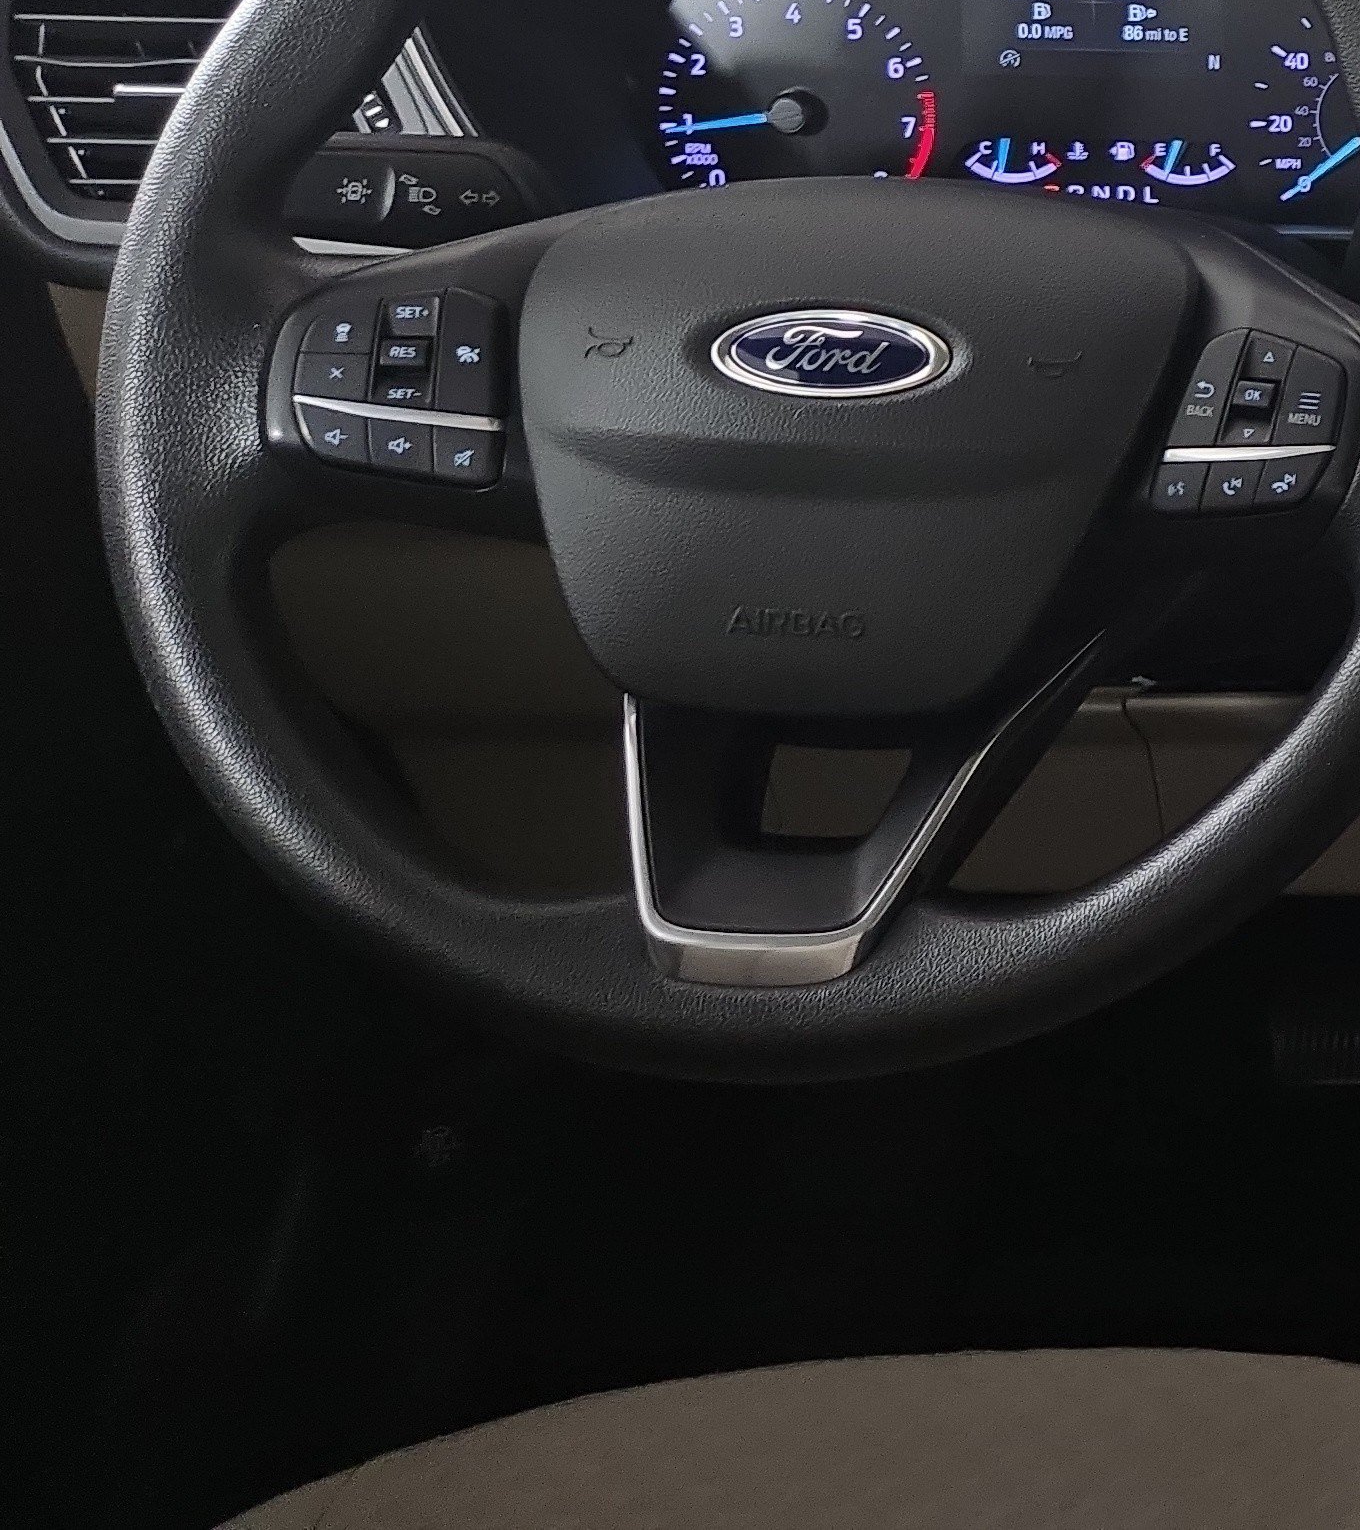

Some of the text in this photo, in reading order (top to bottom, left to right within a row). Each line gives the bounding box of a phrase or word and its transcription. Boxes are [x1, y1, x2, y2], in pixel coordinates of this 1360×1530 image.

[784, 2, 802, 25] 4
[728, 15, 744, 38] 3
[846, 18, 864, 40] 5
[1016, 23, 1074, 40] 0.0 MPG
[1122, 24, 1189, 42] 86 mi to E
[690, 53, 707, 76] 2
[885, 56, 905, 79] 6
[1207, 54, 1222, 70] N
[1284, 52, 1310, 70] 40
[1303, 76, 1319, 88] 60
[1293, 104, 1309, 116] 40
[900, 115, 917, 139] 7
[1267, 115, 1293, 133] 20
[978, 140, 993, 155] C
[1031, 141, 1046, 156] H
[1153, 142, 1167, 157] E
[1208, 143, 1222, 157] F
[1297, 136, 1312, 148] 20
[1274, 157, 1302, 170] MPH
[708, 168, 726, 187] 0
[1142, 185, 1159, 204] L
[394, 305, 430, 320] SET+
[389, 345, 417, 359] RES
[765, 324, 891, 374] Ford
[1244, 388, 1263, 402] OK
[1186, 404, 1215, 418] BACK
[1287, 412, 1322, 427] MENU
[725, 603, 867, 639] AIRBAG
